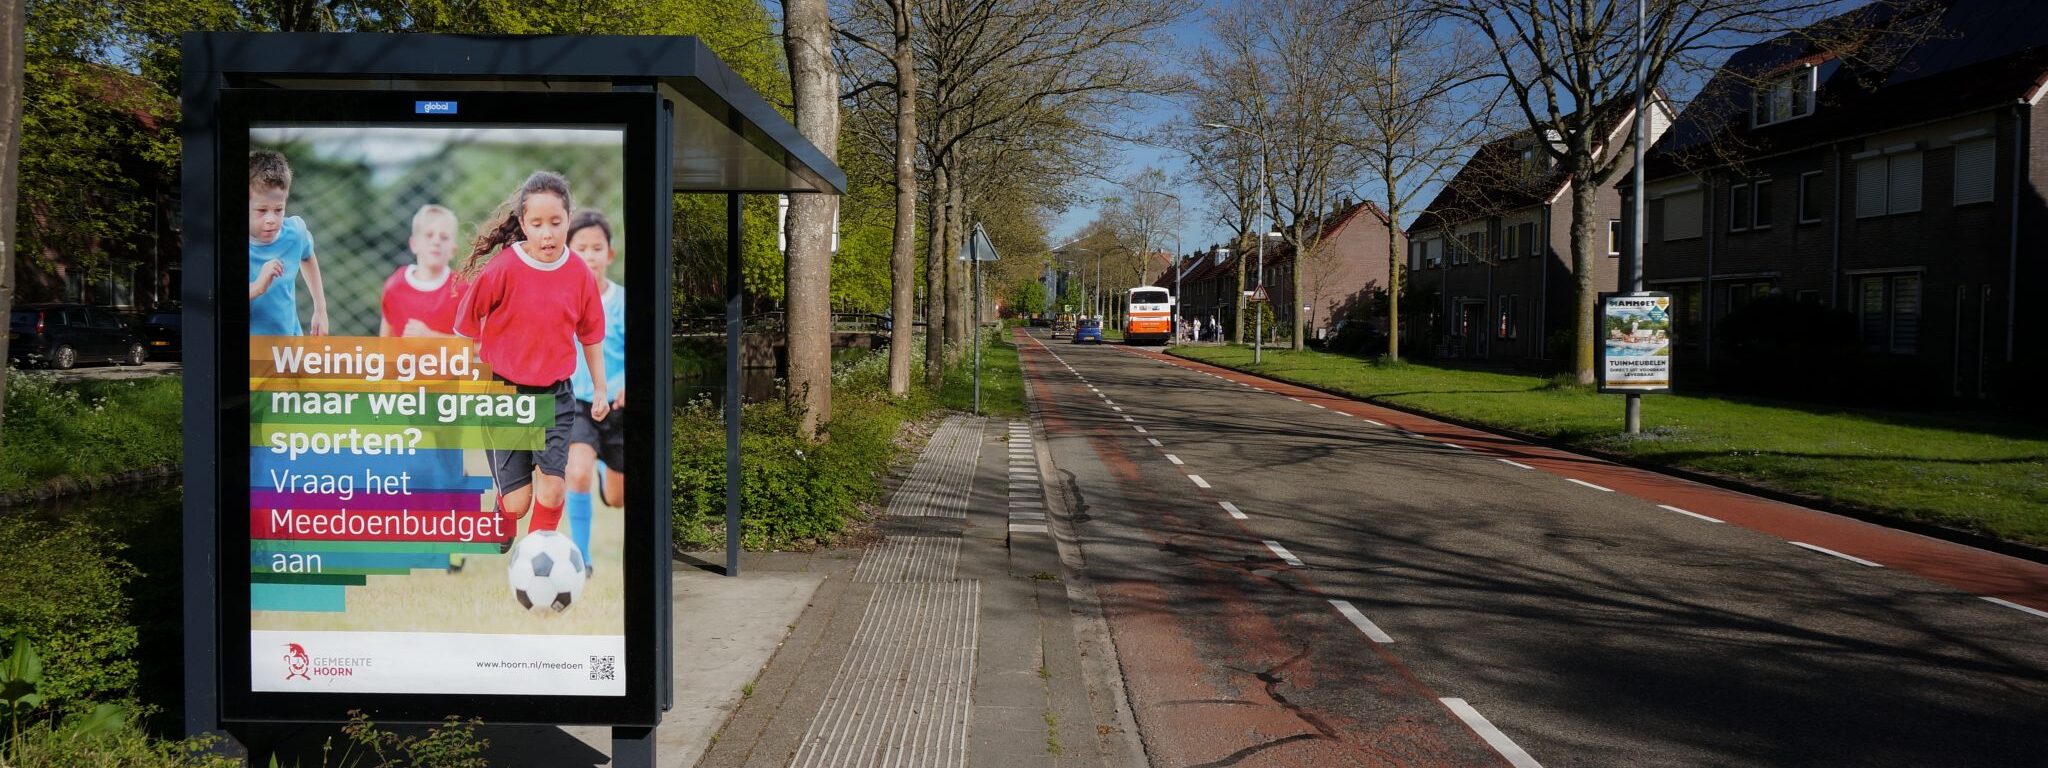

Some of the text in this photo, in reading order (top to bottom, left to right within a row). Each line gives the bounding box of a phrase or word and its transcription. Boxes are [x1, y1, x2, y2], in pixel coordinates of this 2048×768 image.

[424, 101, 448, 113] global
[271, 345, 480, 382] Weinig geld,
[271, 386, 536, 424] maar wel graag
[270, 427, 423, 461] sporten?
[270, 469, 412, 501] Vraag het
[270, 508, 504, 542] Meedoenbudget
[271, 552, 322, 574] aan
[313, 657, 372, 667] GEMEENTE
[313, 667, 353, 676] HOORN
[476, 660, 583, 670] www.hoorn.nl/meedoen
